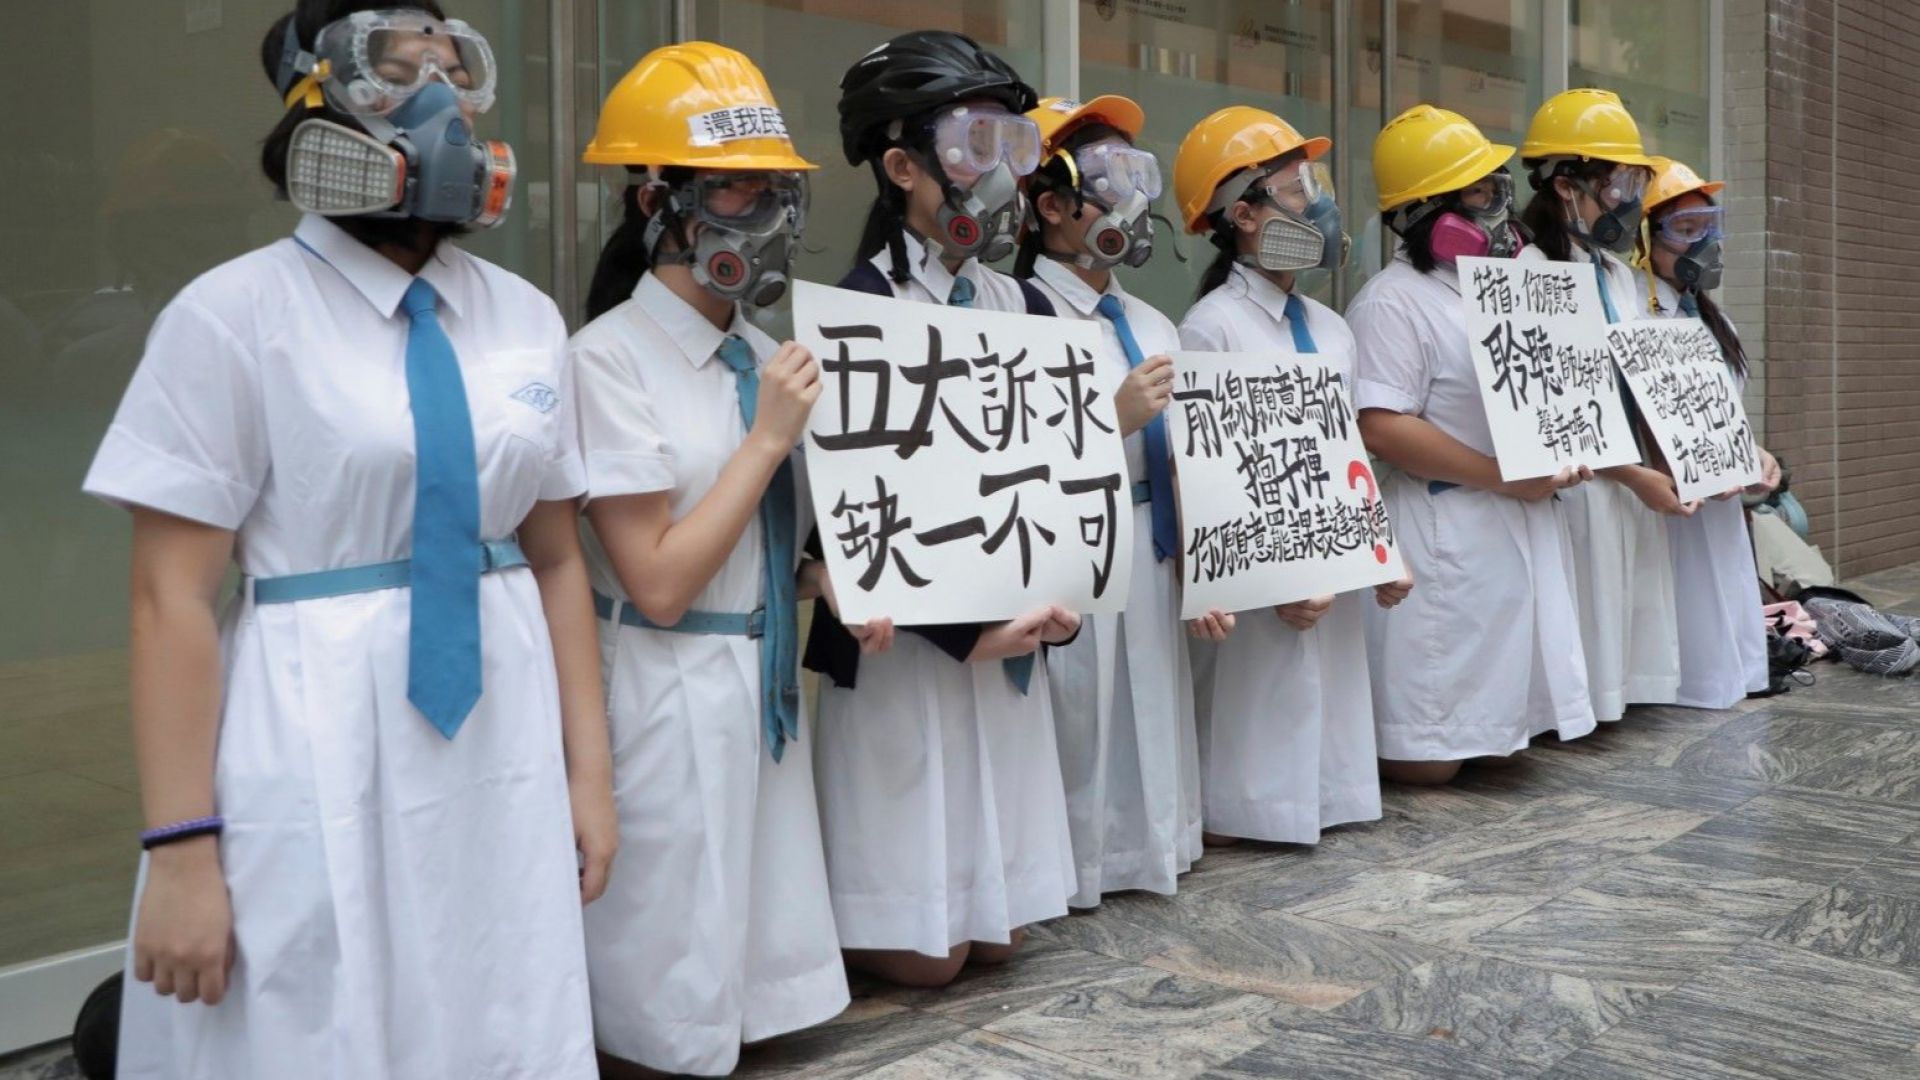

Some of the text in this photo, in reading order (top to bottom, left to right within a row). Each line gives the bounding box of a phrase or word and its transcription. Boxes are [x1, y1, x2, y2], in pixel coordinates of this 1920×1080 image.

[702, 107, 788, 140] 還我民
[811, 324, 1115, 460] 五大訴求
[1233, 435, 1331, 509] 擋子彈
[831, 464, 1121, 599] 缺一不可
